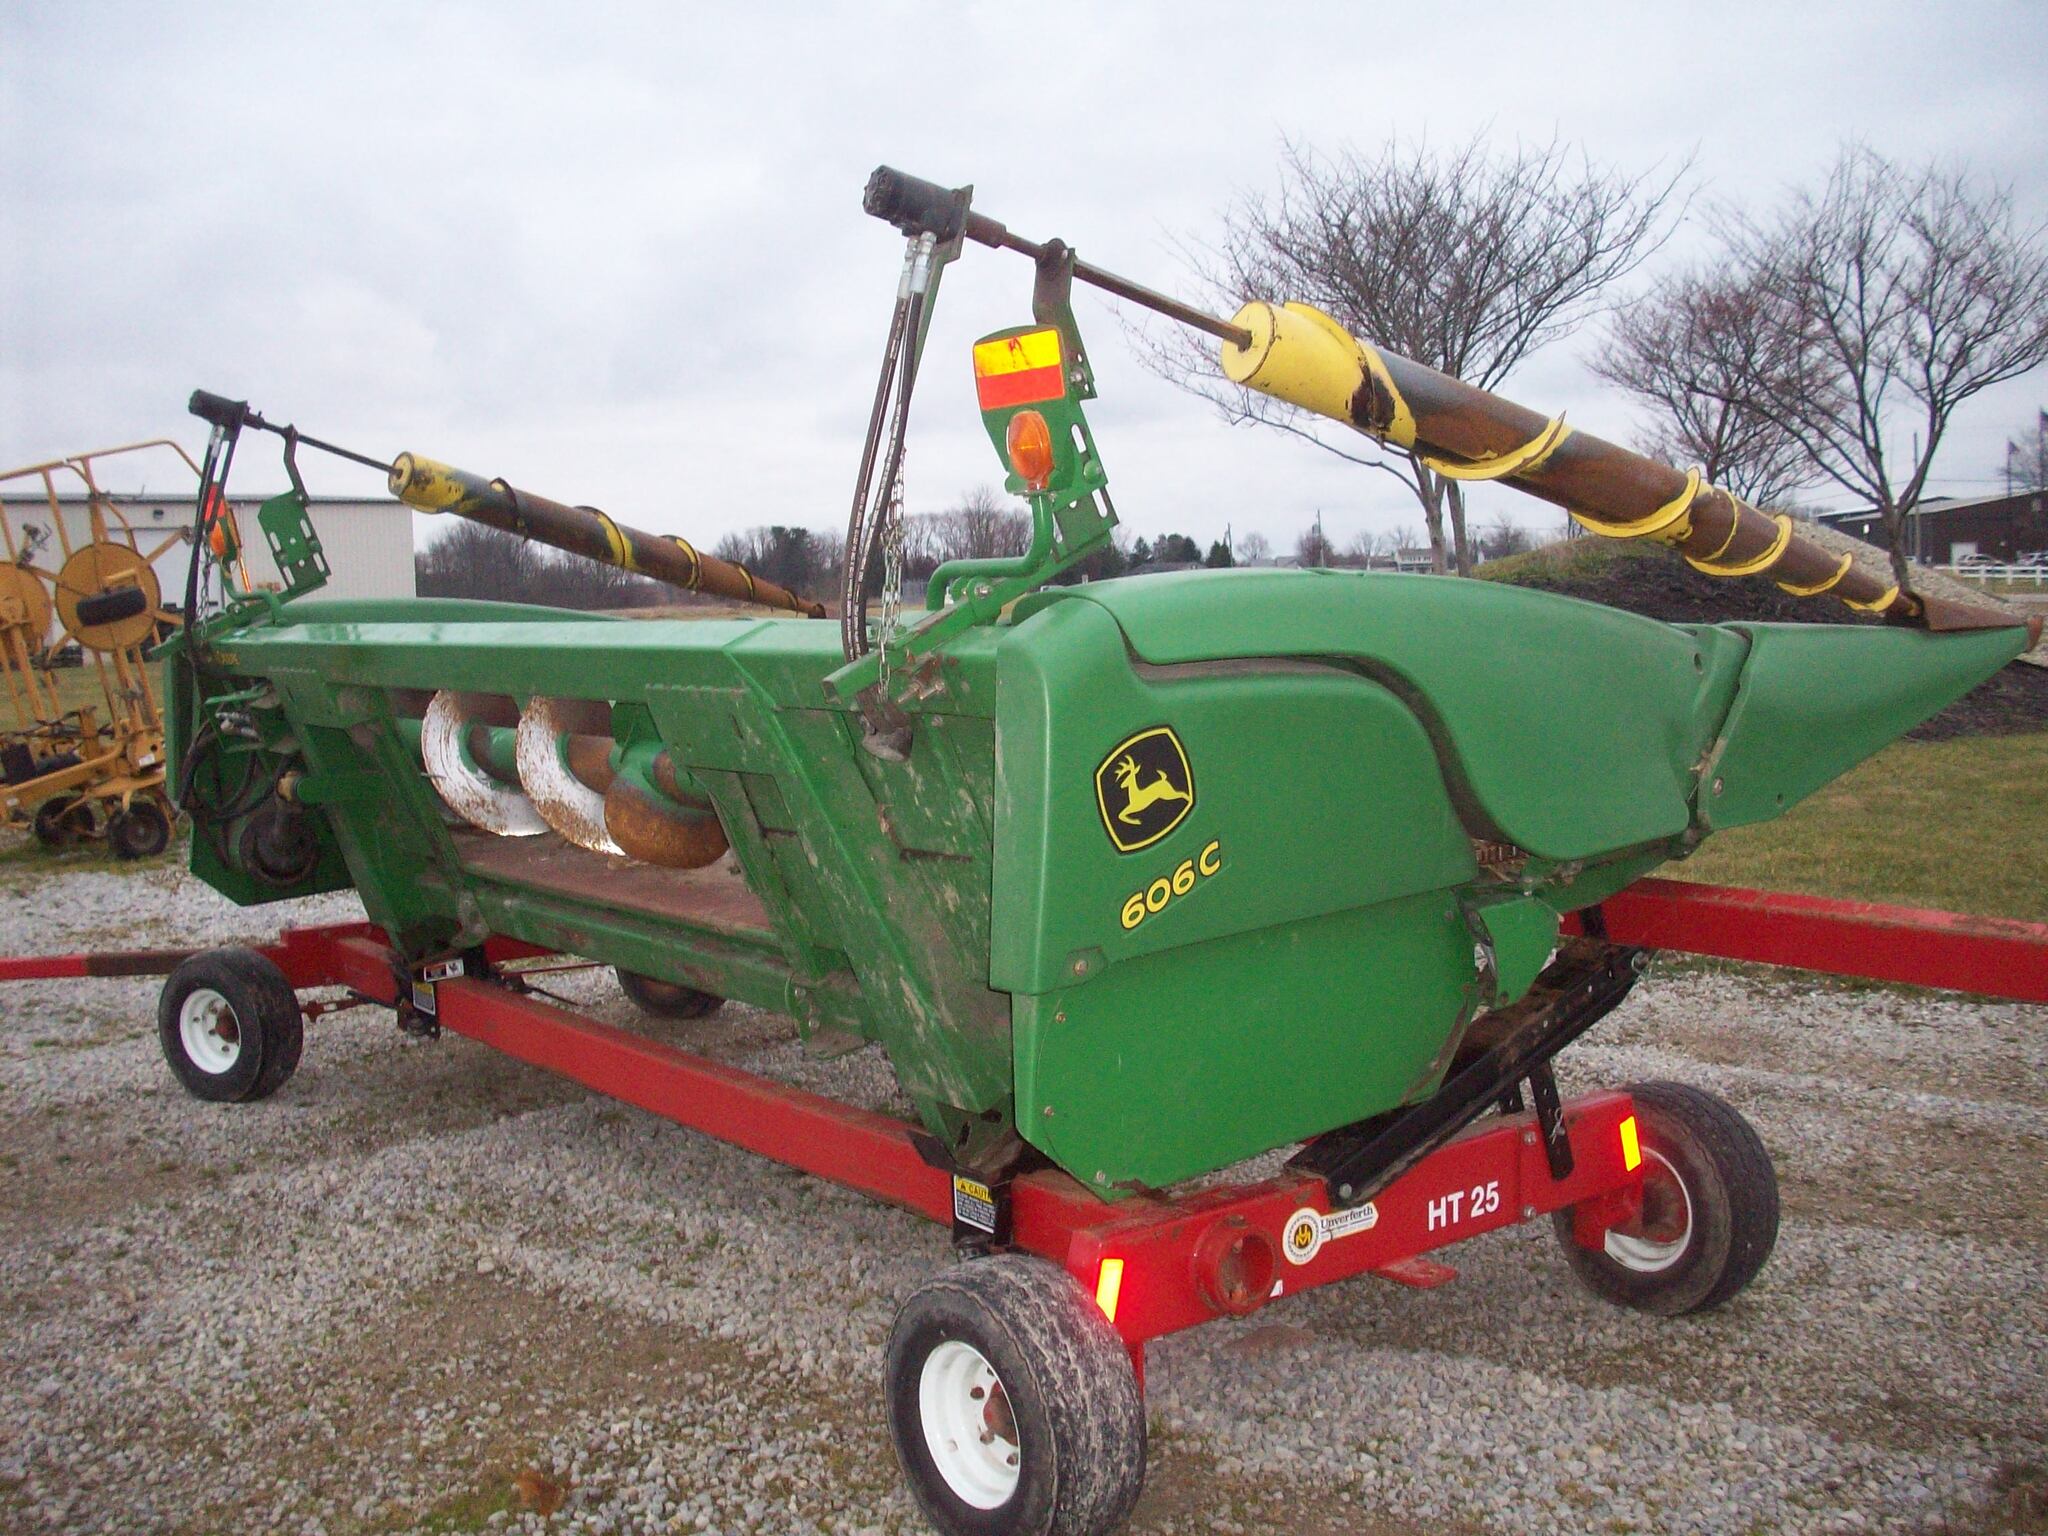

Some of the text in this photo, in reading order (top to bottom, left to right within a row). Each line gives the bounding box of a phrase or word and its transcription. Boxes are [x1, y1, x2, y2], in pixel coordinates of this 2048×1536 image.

[1120, 839, 1221, 929] 606C
[1320, 1205, 1374, 1229] Unverferth
[1428, 1180, 1499, 1232] HT 25
